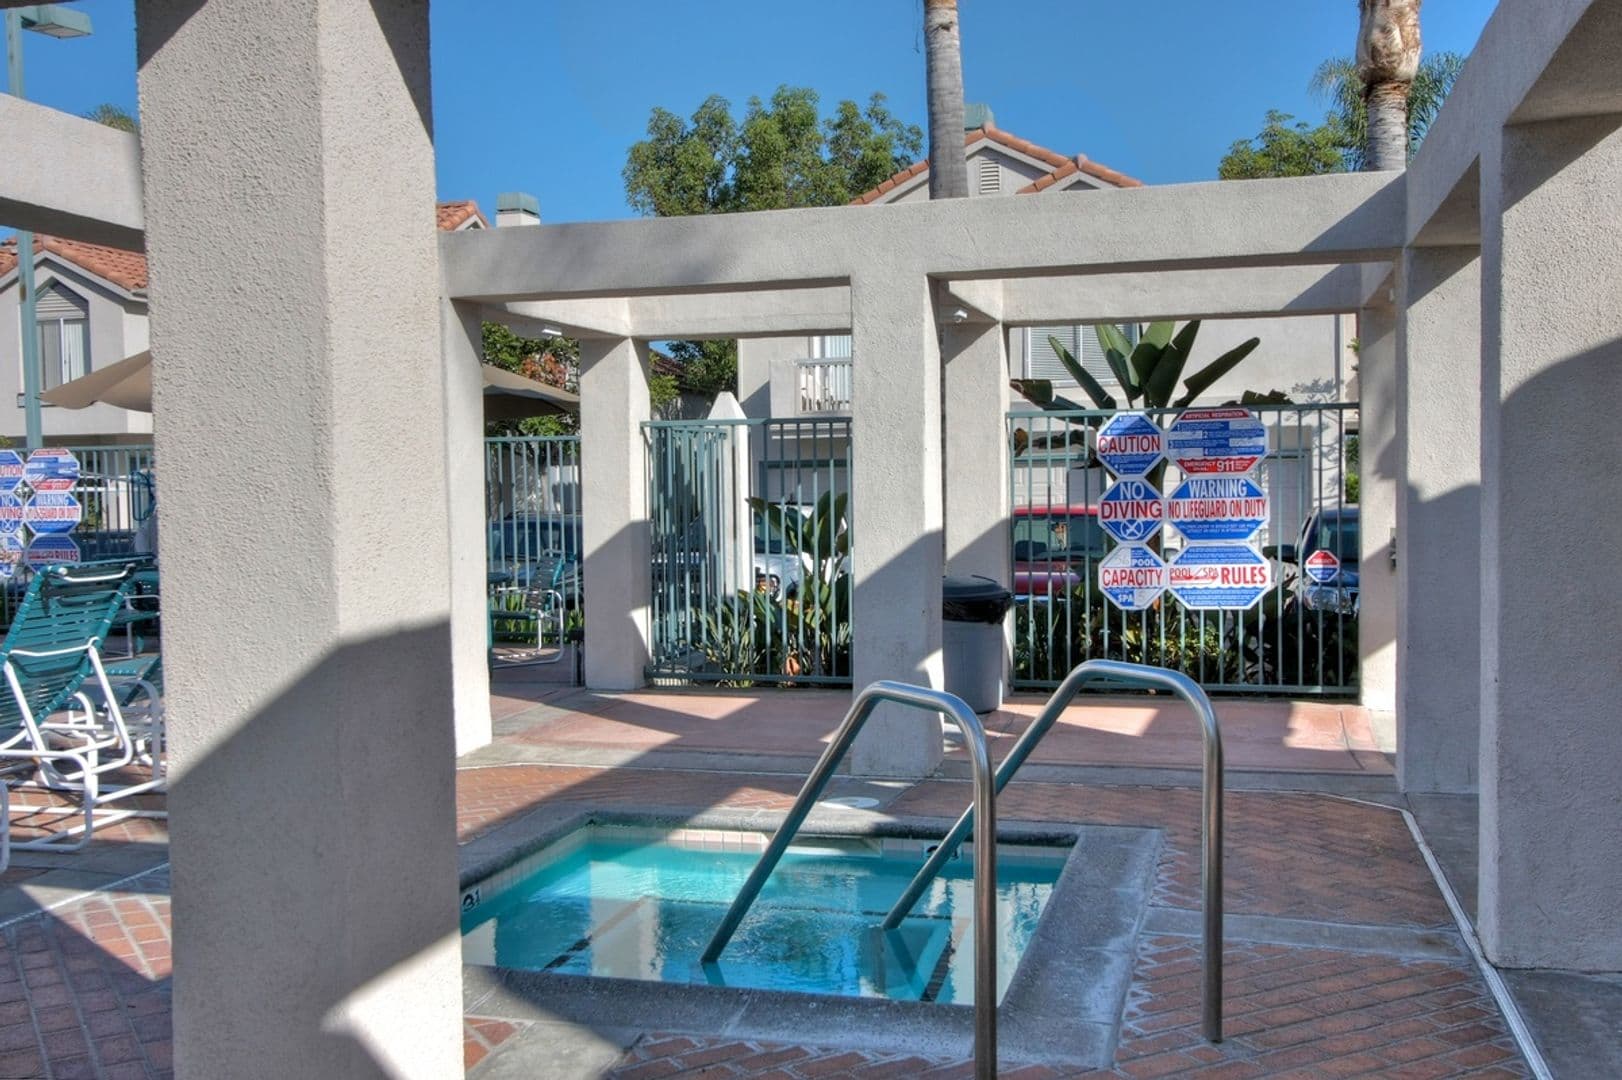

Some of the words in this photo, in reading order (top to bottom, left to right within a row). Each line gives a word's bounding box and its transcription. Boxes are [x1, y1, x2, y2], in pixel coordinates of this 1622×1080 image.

[1099, 435, 1160, 453] CAUTION
[1216, 460, 1235, 472] 911
[1120, 481, 1145, 500] NO
[1188, 479, 1247, 498] WARNING
[1101, 500, 1163, 519] DIVING
[1168, 501, 1181, 518] NO
[1183, 500, 1227, 518] LIFEGUARD
[1230, 500, 1242, 517] ON
[1245, 499, 1266, 516] DUTY
[1132, 559, 1155, 567] POOL
[1103, 568, 1163, 586] CAPACITY
[1169, 568, 1191, 577] POOL
[1202, 568, 1219, 577] SPA
[1220, 566, 1267, 585] RULES
[1118, 594, 1133, 602] SPA
